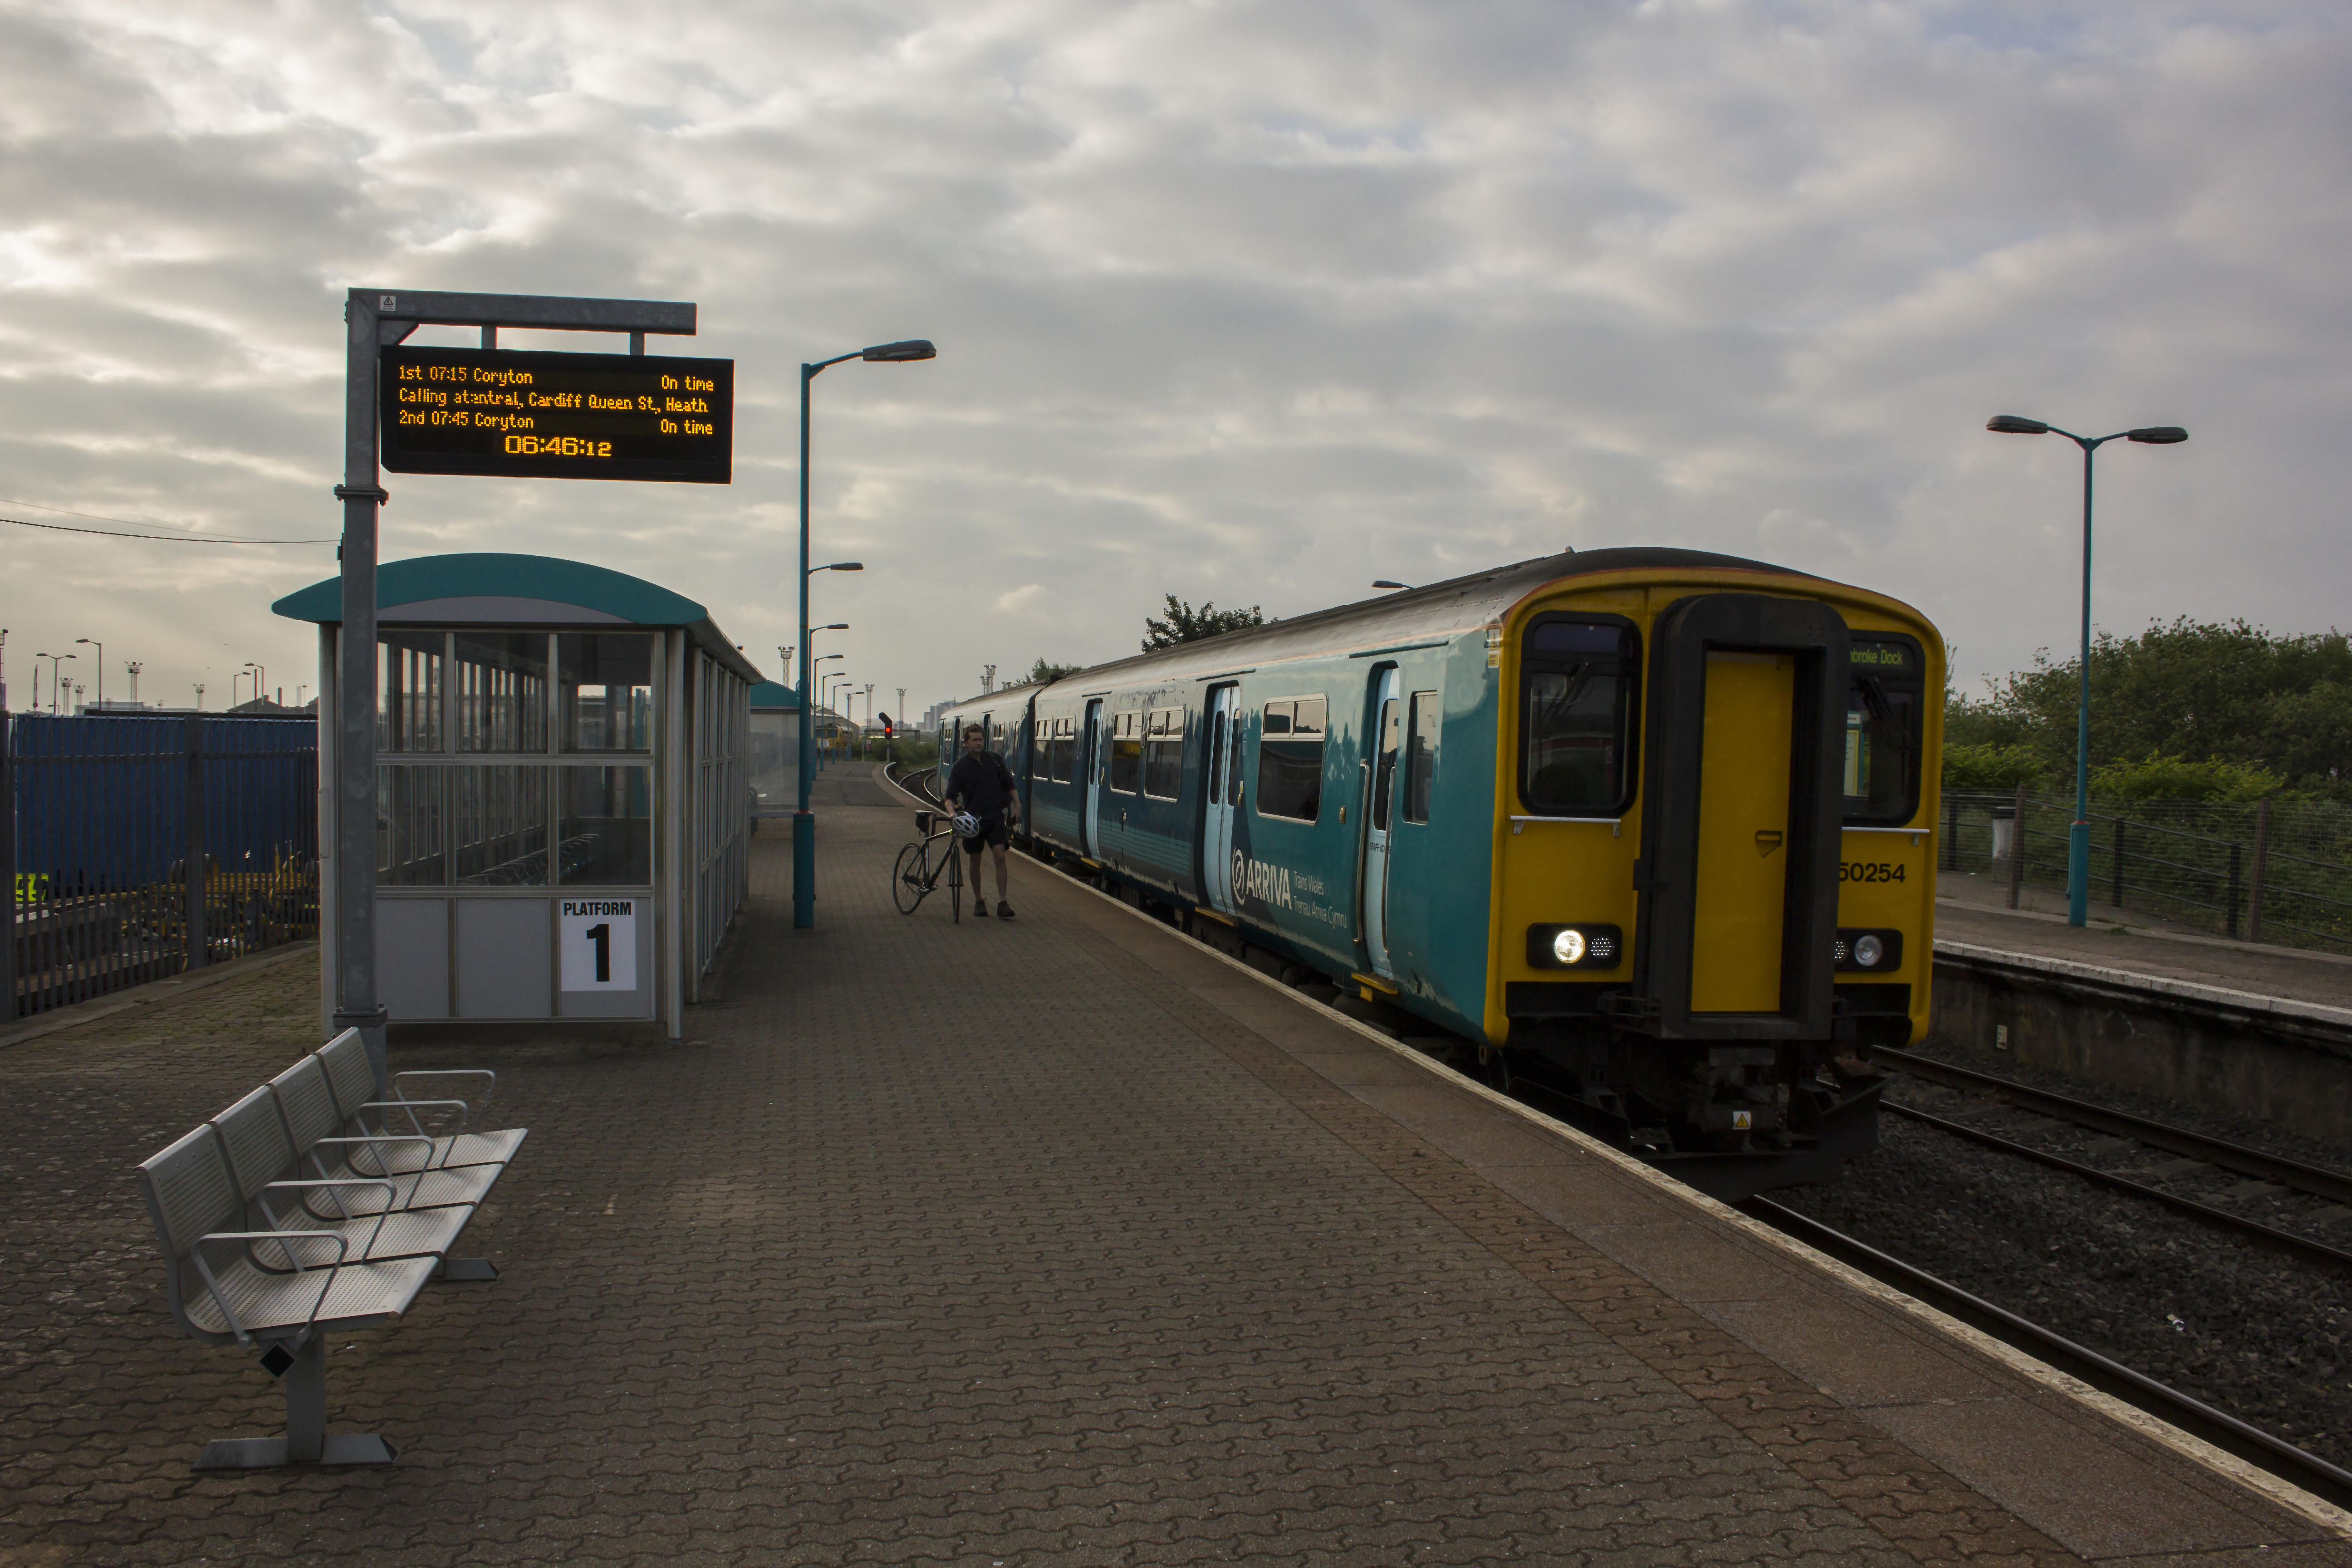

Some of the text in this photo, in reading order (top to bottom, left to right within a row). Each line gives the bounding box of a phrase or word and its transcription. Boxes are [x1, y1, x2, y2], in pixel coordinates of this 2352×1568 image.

[400, 366, 714, 391] 1st 07:15 Coryton On time
[400, 388, 446, 406] Calling
[529, 392, 582, 407] Cardiff
[589, 394, 633, 409] Queen
[666, 397, 708, 412] Heath
[400, 410, 713, 435] 2nd 07:45 Coryton On time
[505, 436, 611, 456] 06:46:12
[1850, 648, 1903, 665] broke Dock
[1246, 859, 1292, 910] ARRIVA
[1294, 871, 1324, 895] Trains Wales
[564, 902, 632, 916] PLATFORM
[1294, 896, 1347, 929] Trenau Arriva Cymru
[587, 923, 610, 982] 1
